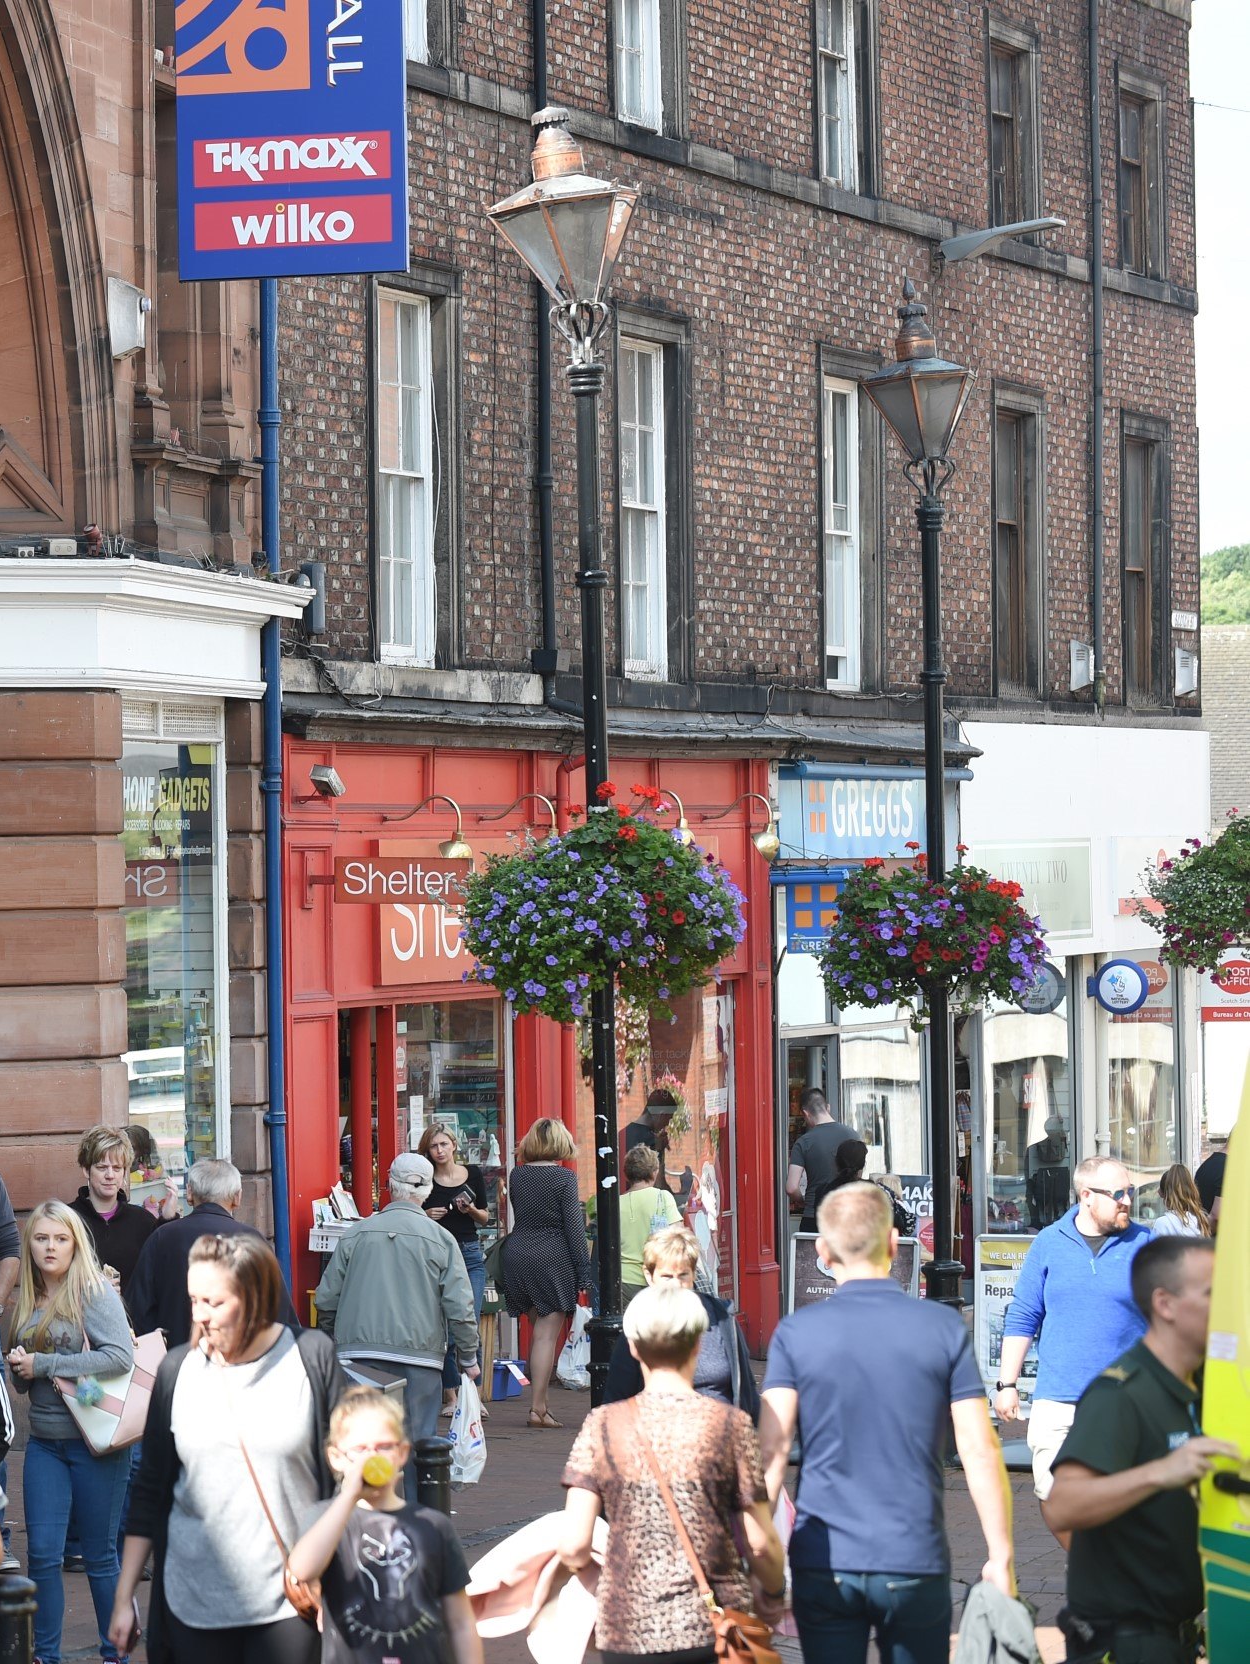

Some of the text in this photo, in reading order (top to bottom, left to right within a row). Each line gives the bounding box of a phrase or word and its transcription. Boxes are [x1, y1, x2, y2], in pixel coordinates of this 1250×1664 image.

[231, 203, 355, 246] wilko
[159, 777, 210, 812] GADGETS
[831, 778, 913, 838] GREGGS
[344, 862, 456, 895] Shelter
[1046, 860, 1068, 883] TWO
[989, 1252, 1001, 1260] WE
[1002, 1252, 1016, 1260] CAN
